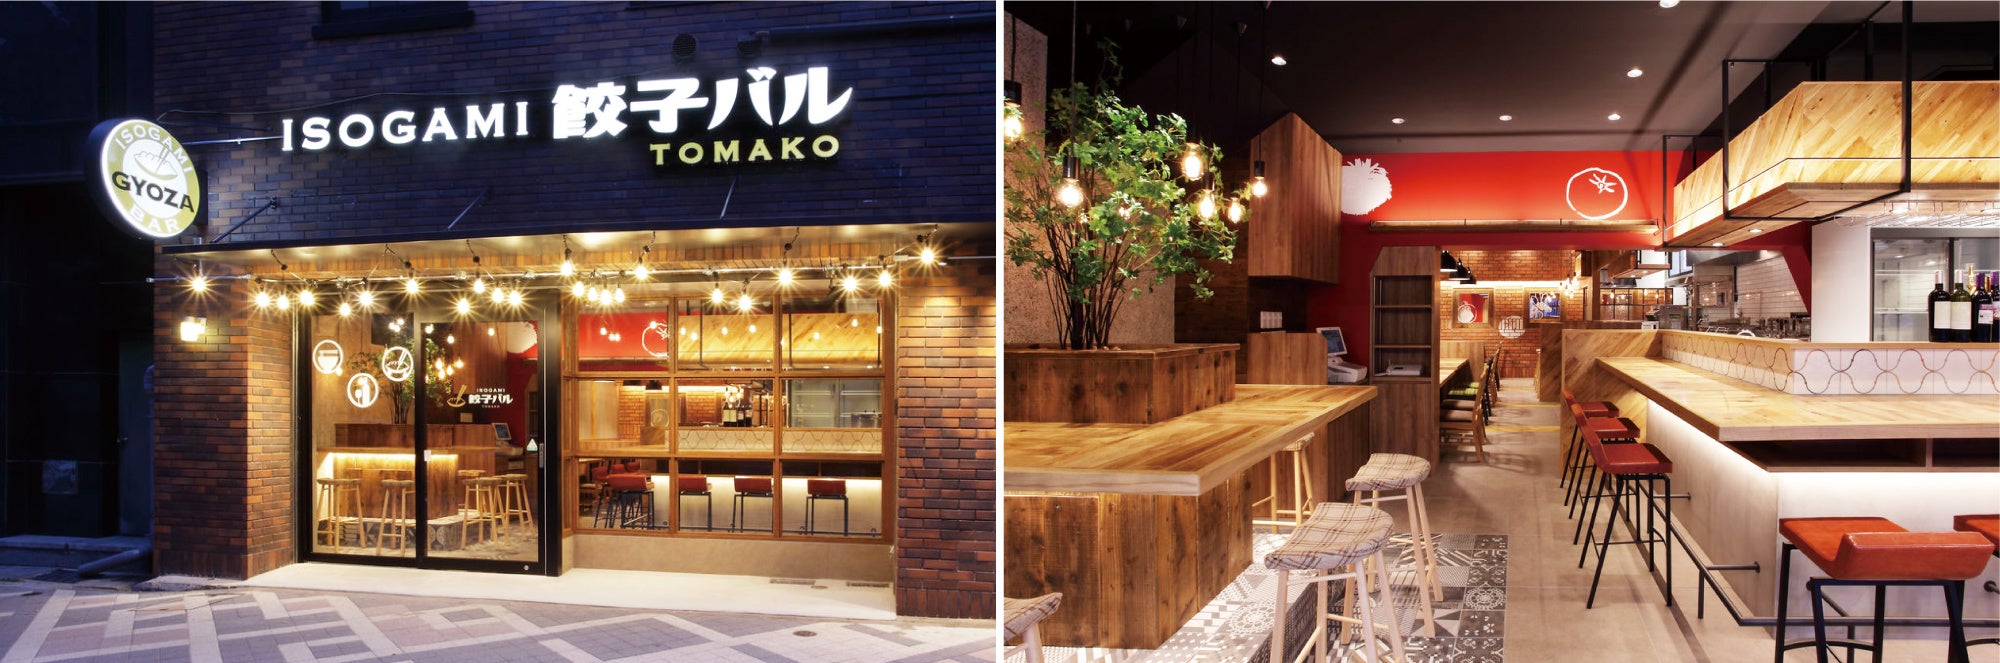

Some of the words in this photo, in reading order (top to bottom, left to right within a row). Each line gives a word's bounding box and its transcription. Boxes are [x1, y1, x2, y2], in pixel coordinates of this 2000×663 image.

[281, 101, 529, 151] ISOGAMI
[552, 65, 854, 140] 餃子バル
[114, 123, 194, 173] ISOGAMI
[649, 133, 841, 166] TOMAKO
[111, 170, 195, 213] GYOZA
[127, 203, 180, 234] BAR
